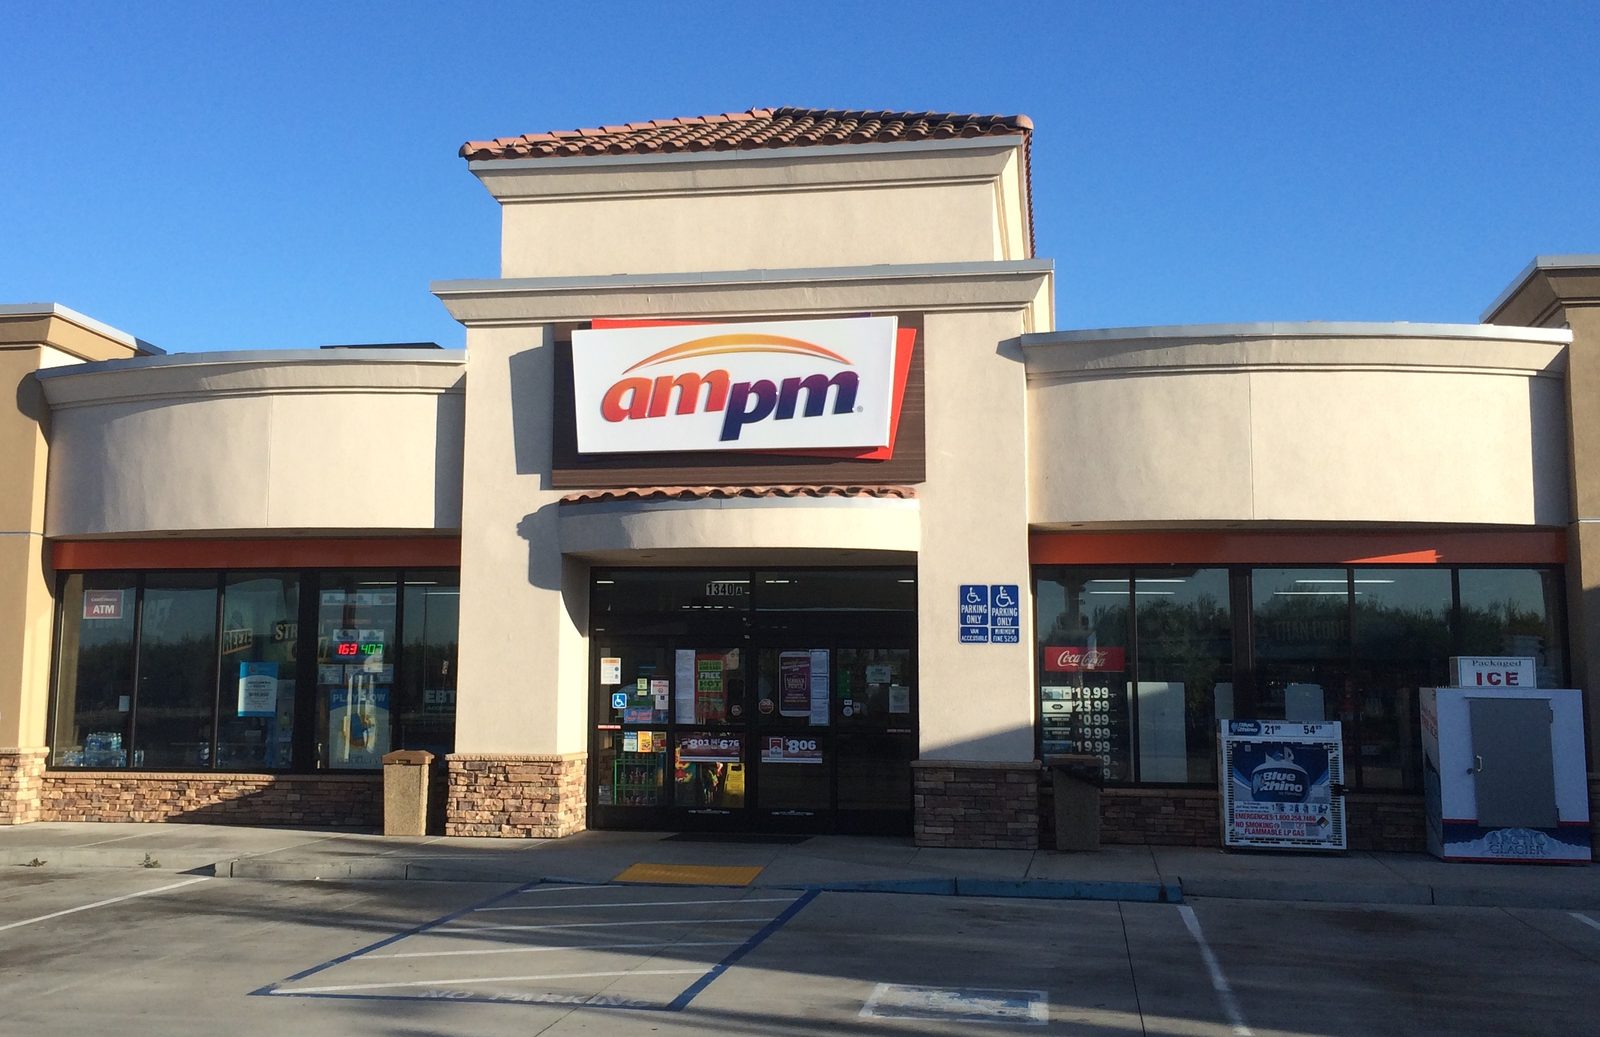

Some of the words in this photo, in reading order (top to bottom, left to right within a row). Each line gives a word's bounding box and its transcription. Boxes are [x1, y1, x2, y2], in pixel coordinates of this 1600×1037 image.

[601, 368, 860, 442] ampm
[707, 584, 735, 596] 1340
[92, 604, 115, 615] ATM
[960, 604, 988, 614] PARKING
[991, 607, 1018, 617] PARKING
[966, 615, 982, 624] ONLY
[996, 617, 1013, 626] ONLY
[337, 643, 358, 655] 163
[360, 643, 384, 655] 407
[1472, 660, 1522, 668] Packaged
[1476, 671, 1519, 686] ICE
[1263, 772, 1296, 782] Blue
[1260, 781, 1303, 792] Rhino
[1245, 821, 1273, 829] SMOKING
[1244, 828, 1282, 836] FLAMMABLE
